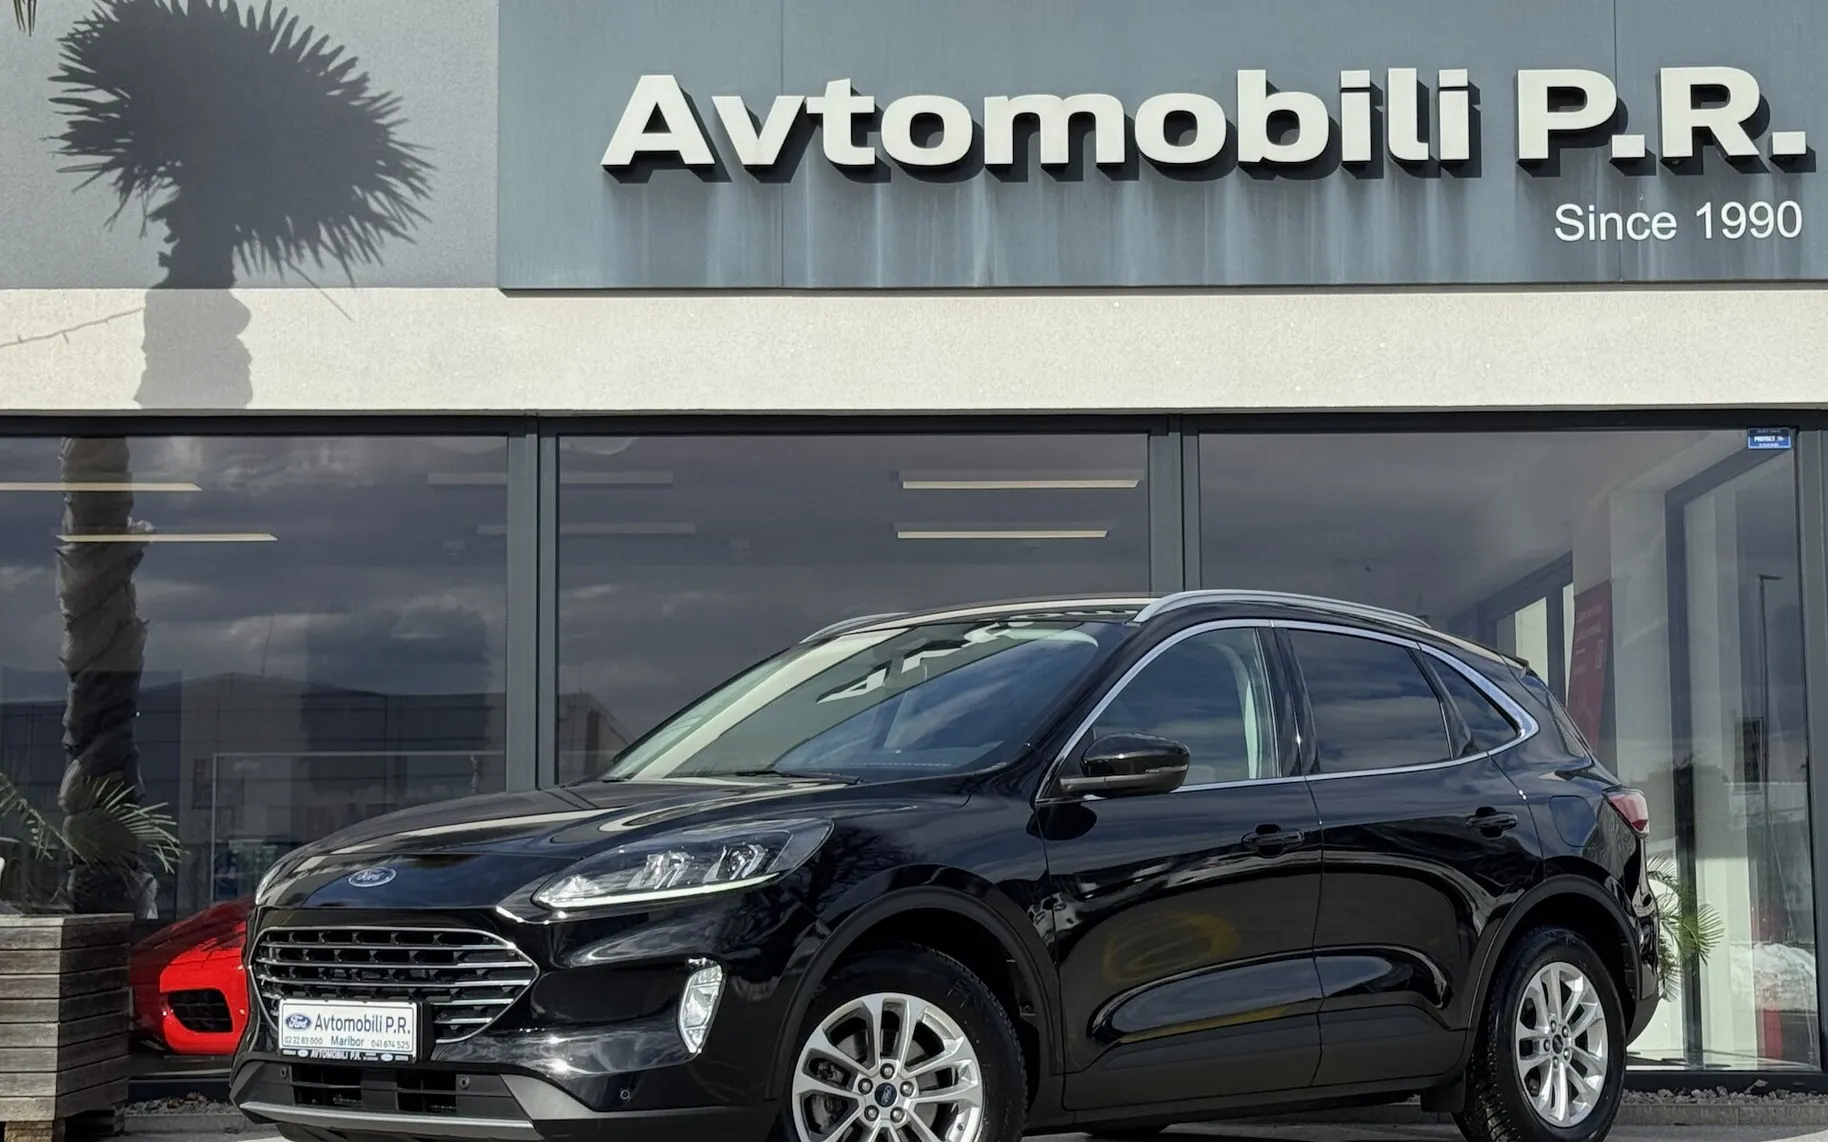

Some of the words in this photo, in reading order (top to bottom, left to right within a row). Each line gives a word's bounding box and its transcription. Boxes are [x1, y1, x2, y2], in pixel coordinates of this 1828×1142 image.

[600, 68, 1469, 167] Avtomobili
[1516, 66, 1807, 161] P.R.
[1555, 203, 1677, 242] Since
[1696, 201, 1802, 240] 1990
[288, 1015, 308, 1028] Ford
[314, 1013, 382, 1032] Avtomobili
[385, 1016, 411, 1034] P.R.
[330, 1036, 364, 1047] Maribor
